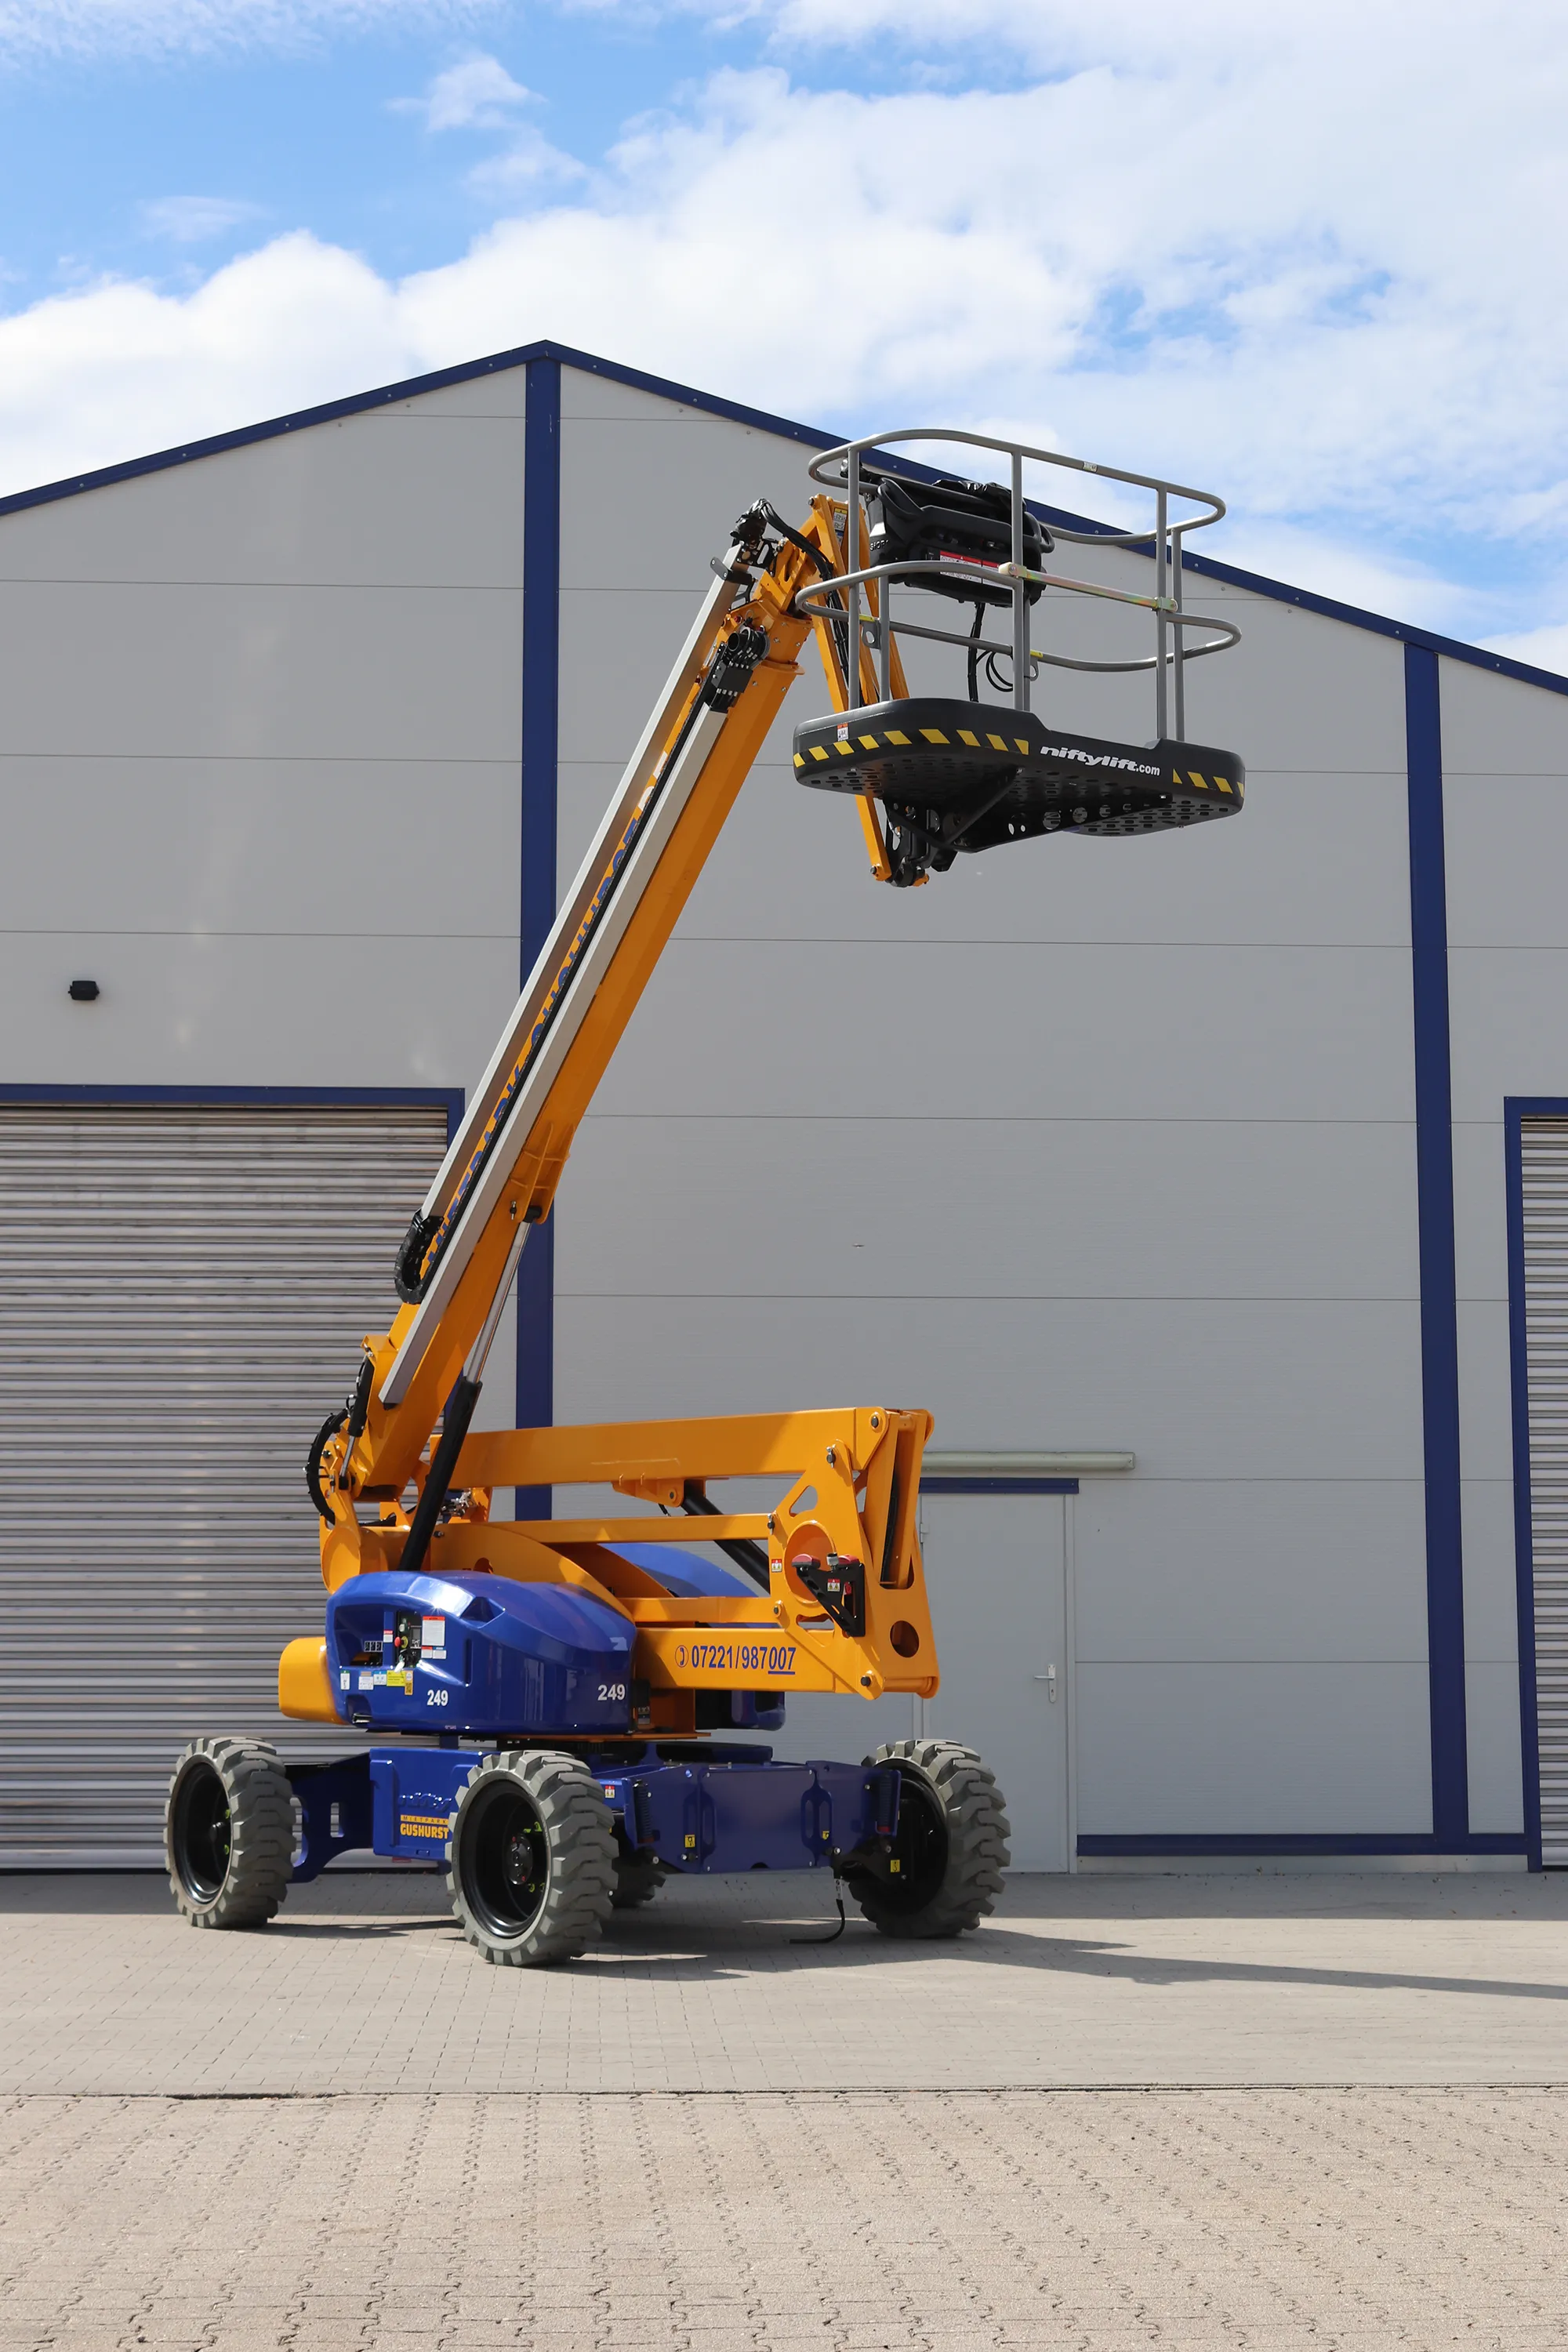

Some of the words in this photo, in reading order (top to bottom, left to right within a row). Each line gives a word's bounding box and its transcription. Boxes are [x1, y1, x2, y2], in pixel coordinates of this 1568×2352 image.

[1040, 746, 1160, 776] niftylift.com
[691, 1645, 797, 1671] 07221/987007
[426, 1689, 448, 1707] 249
[597, 1683, 626, 1701] 249
[402, 1816, 446, 1824] MIETPARK
[400, 1823, 449, 1840] GUSHURST
